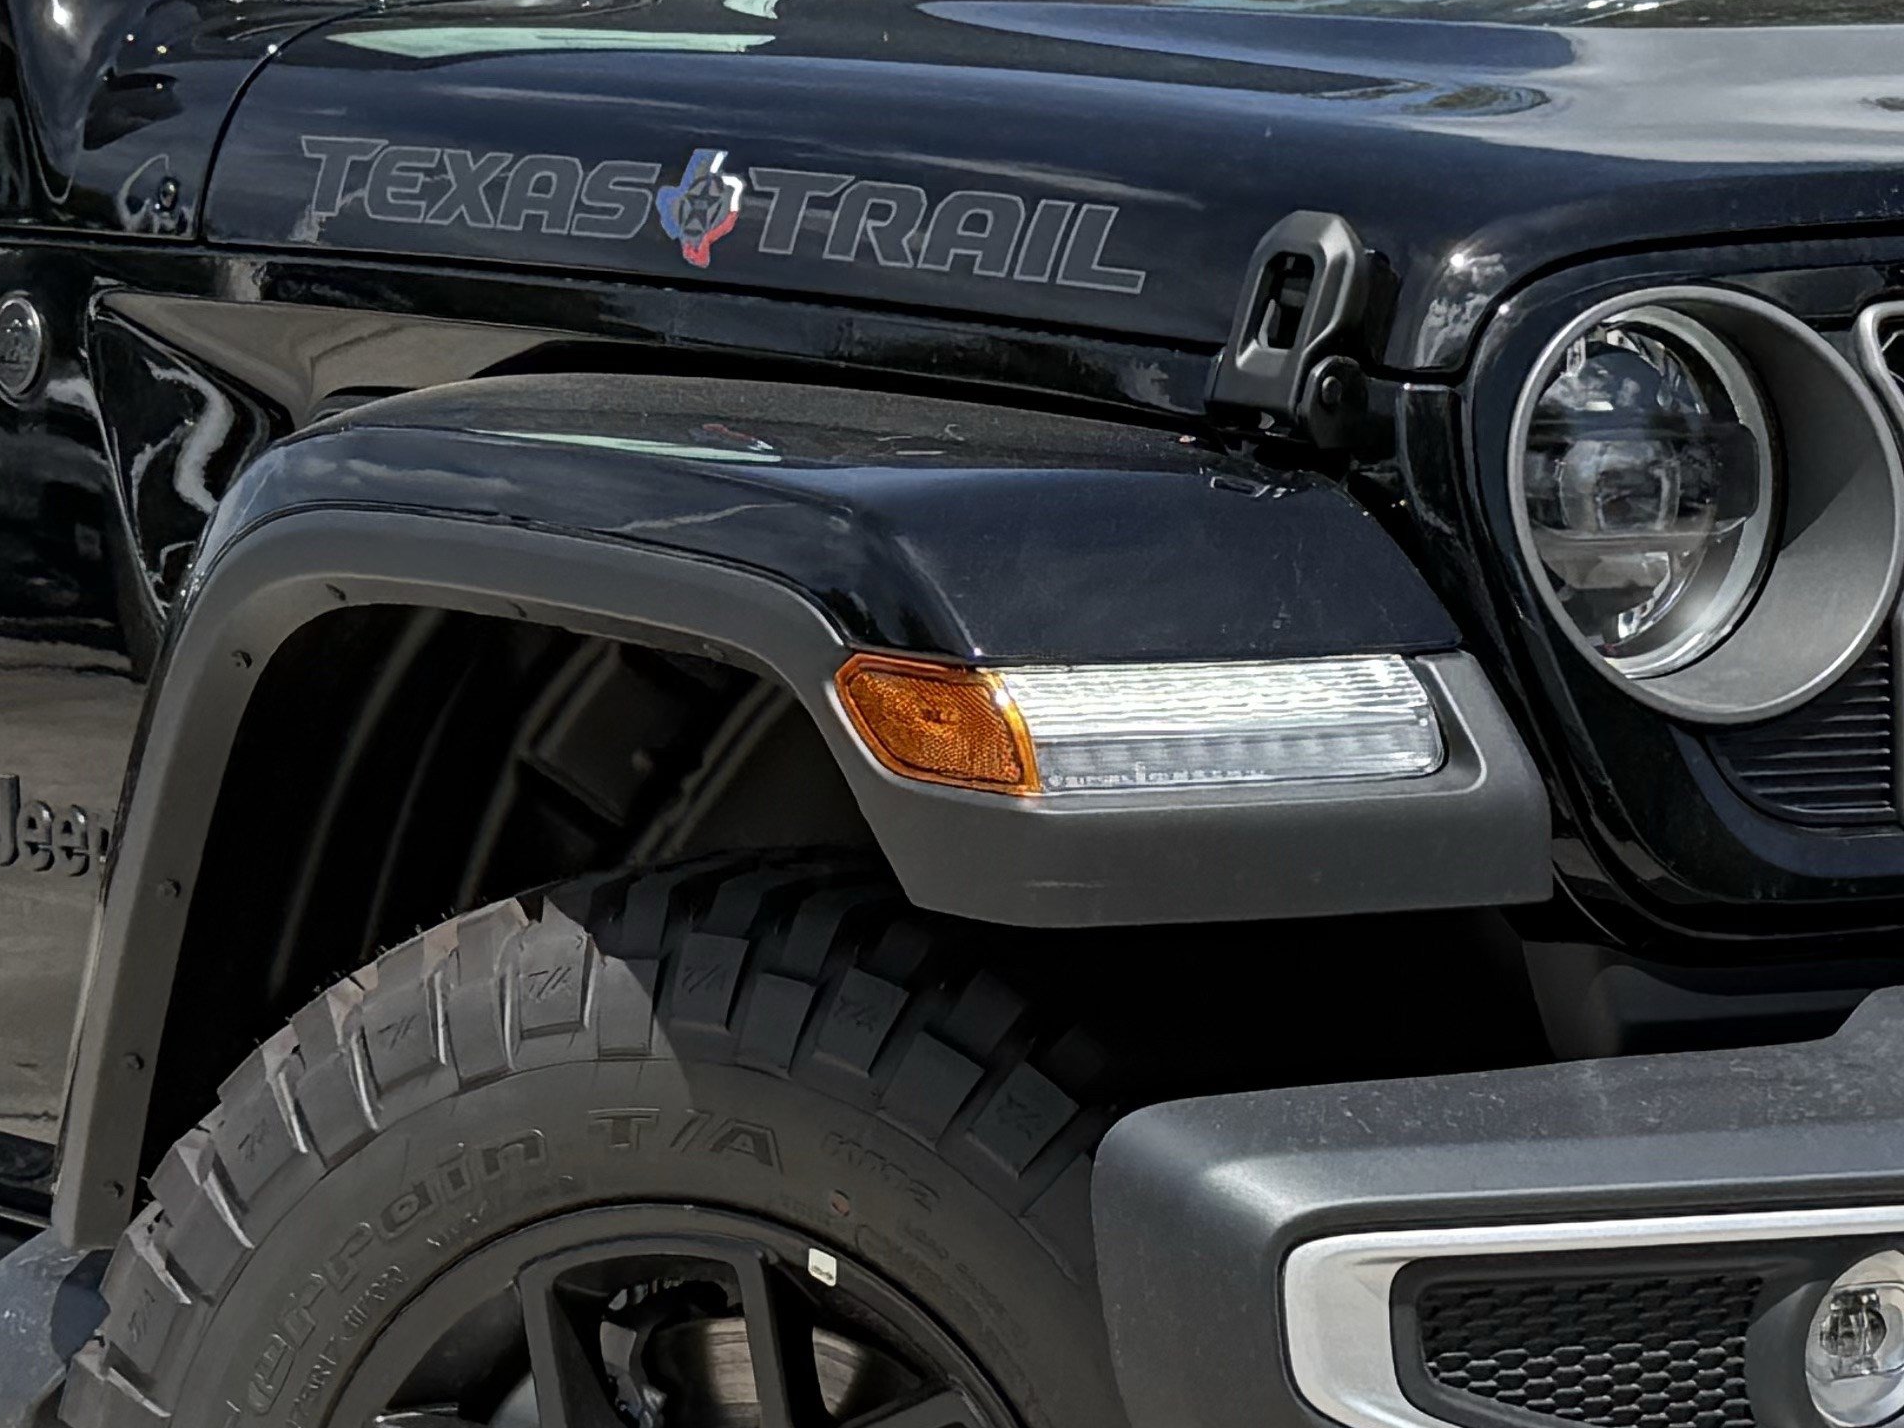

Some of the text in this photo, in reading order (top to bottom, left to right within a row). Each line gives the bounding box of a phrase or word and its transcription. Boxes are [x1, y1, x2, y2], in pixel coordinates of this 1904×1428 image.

[301, 135, 1146, 294] TEXAS TRAIL
[587, 1105, 786, 1174] T/A
